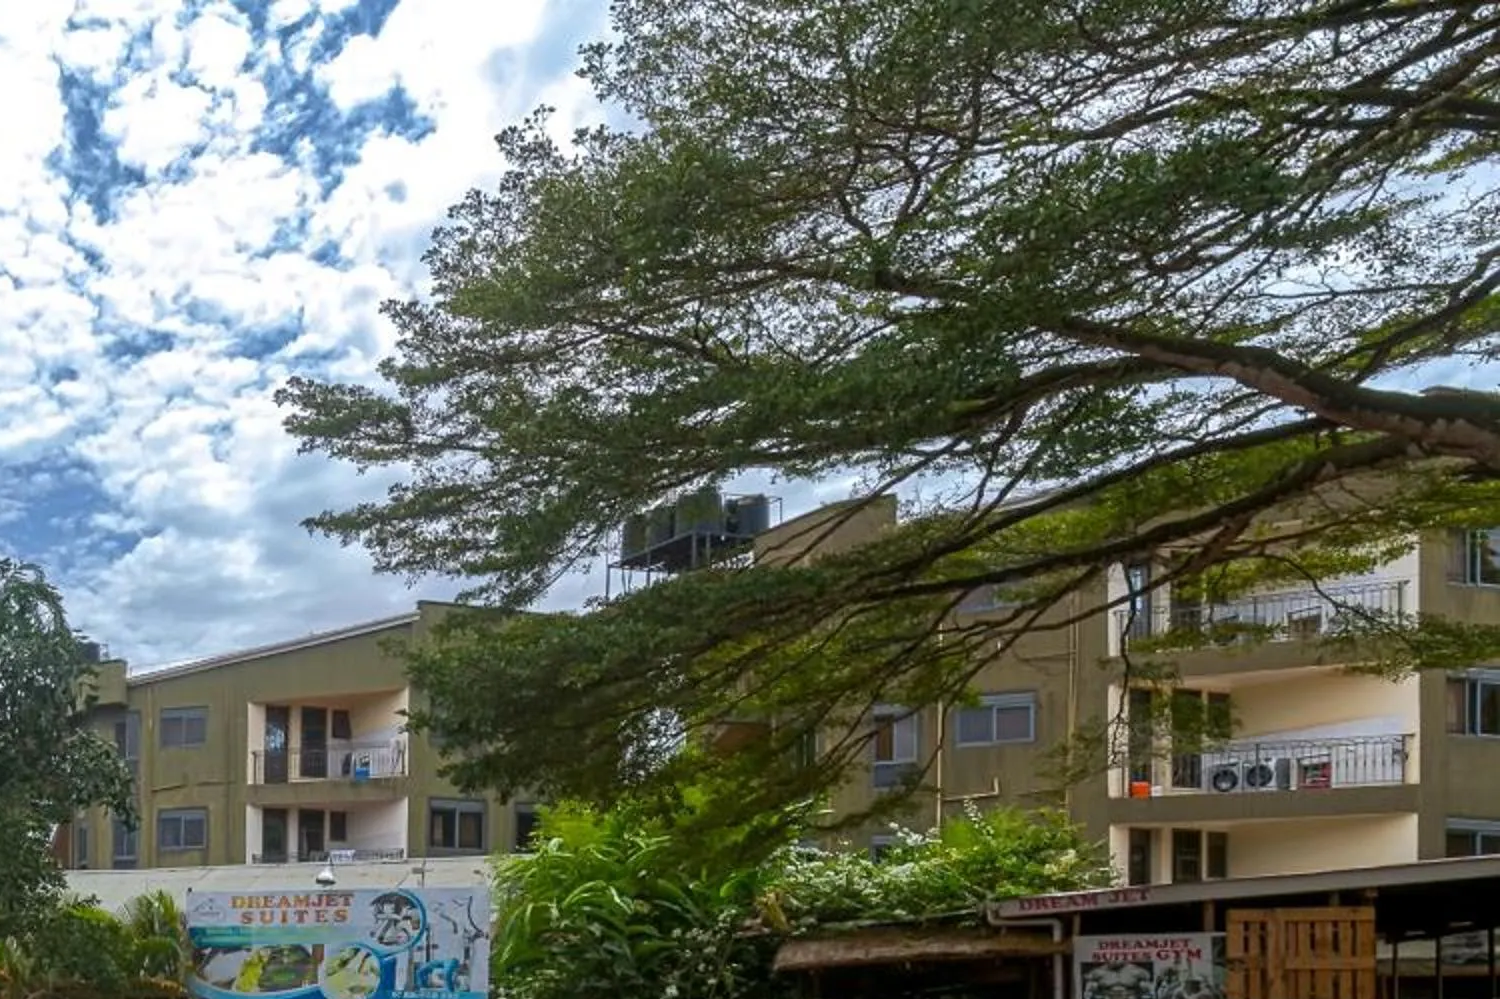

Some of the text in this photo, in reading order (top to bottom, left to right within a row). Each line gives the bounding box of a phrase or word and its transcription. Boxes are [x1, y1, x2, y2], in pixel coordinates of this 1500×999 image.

[230, 893, 354, 908] DREAMJET
[1018, 888, 1151, 911] DREAM JET
[240, 909, 349, 924] SUITES
[1098, 937, 1192, 951] DREAMJET
[1092, 948, 1202, 962] SUITES GYM
